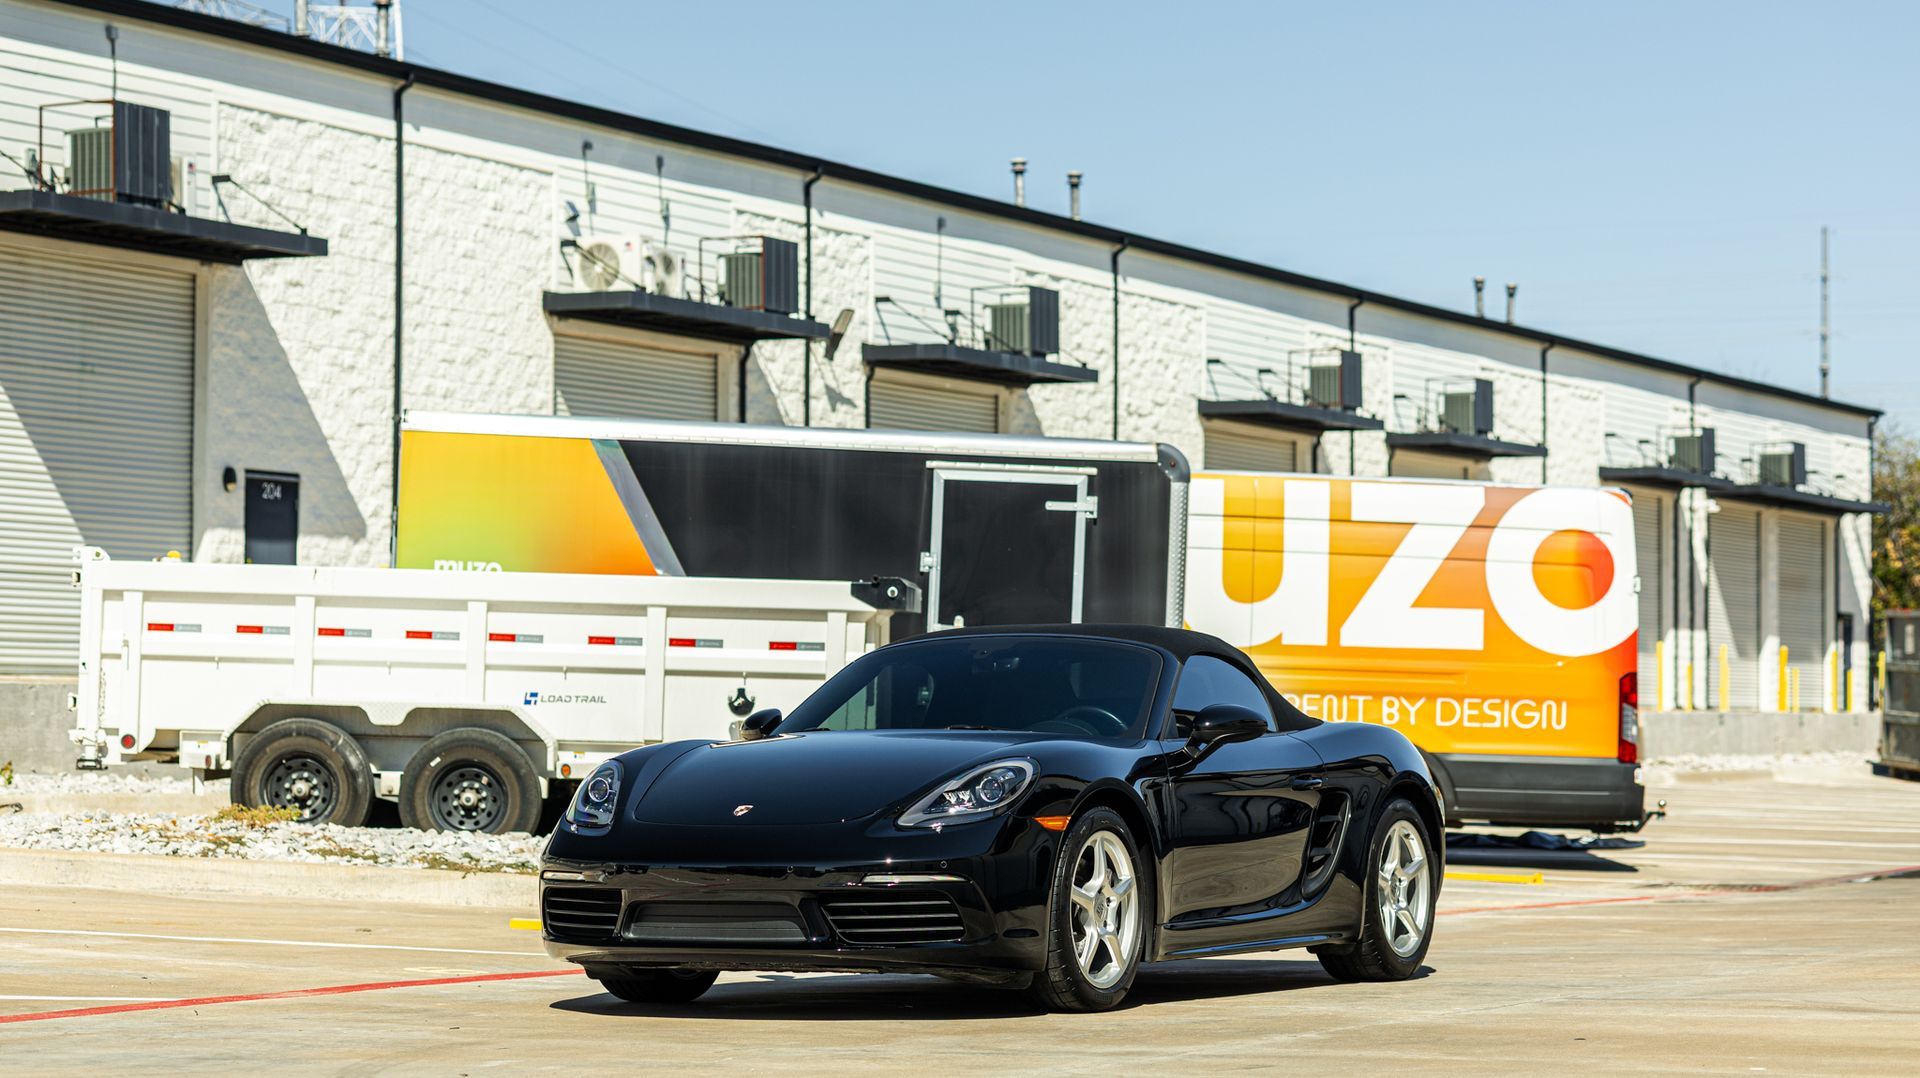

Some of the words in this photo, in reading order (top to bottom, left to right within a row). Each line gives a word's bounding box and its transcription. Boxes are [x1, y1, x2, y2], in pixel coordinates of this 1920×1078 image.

[262, 482, 282, 500] 204
[540, 695, 572, 704] LOAD
[575, 695, 607, 704] TRAIL
[1382, 696, 1427, 726] BY
[1436, 697, 1567, 730] DESIGN
